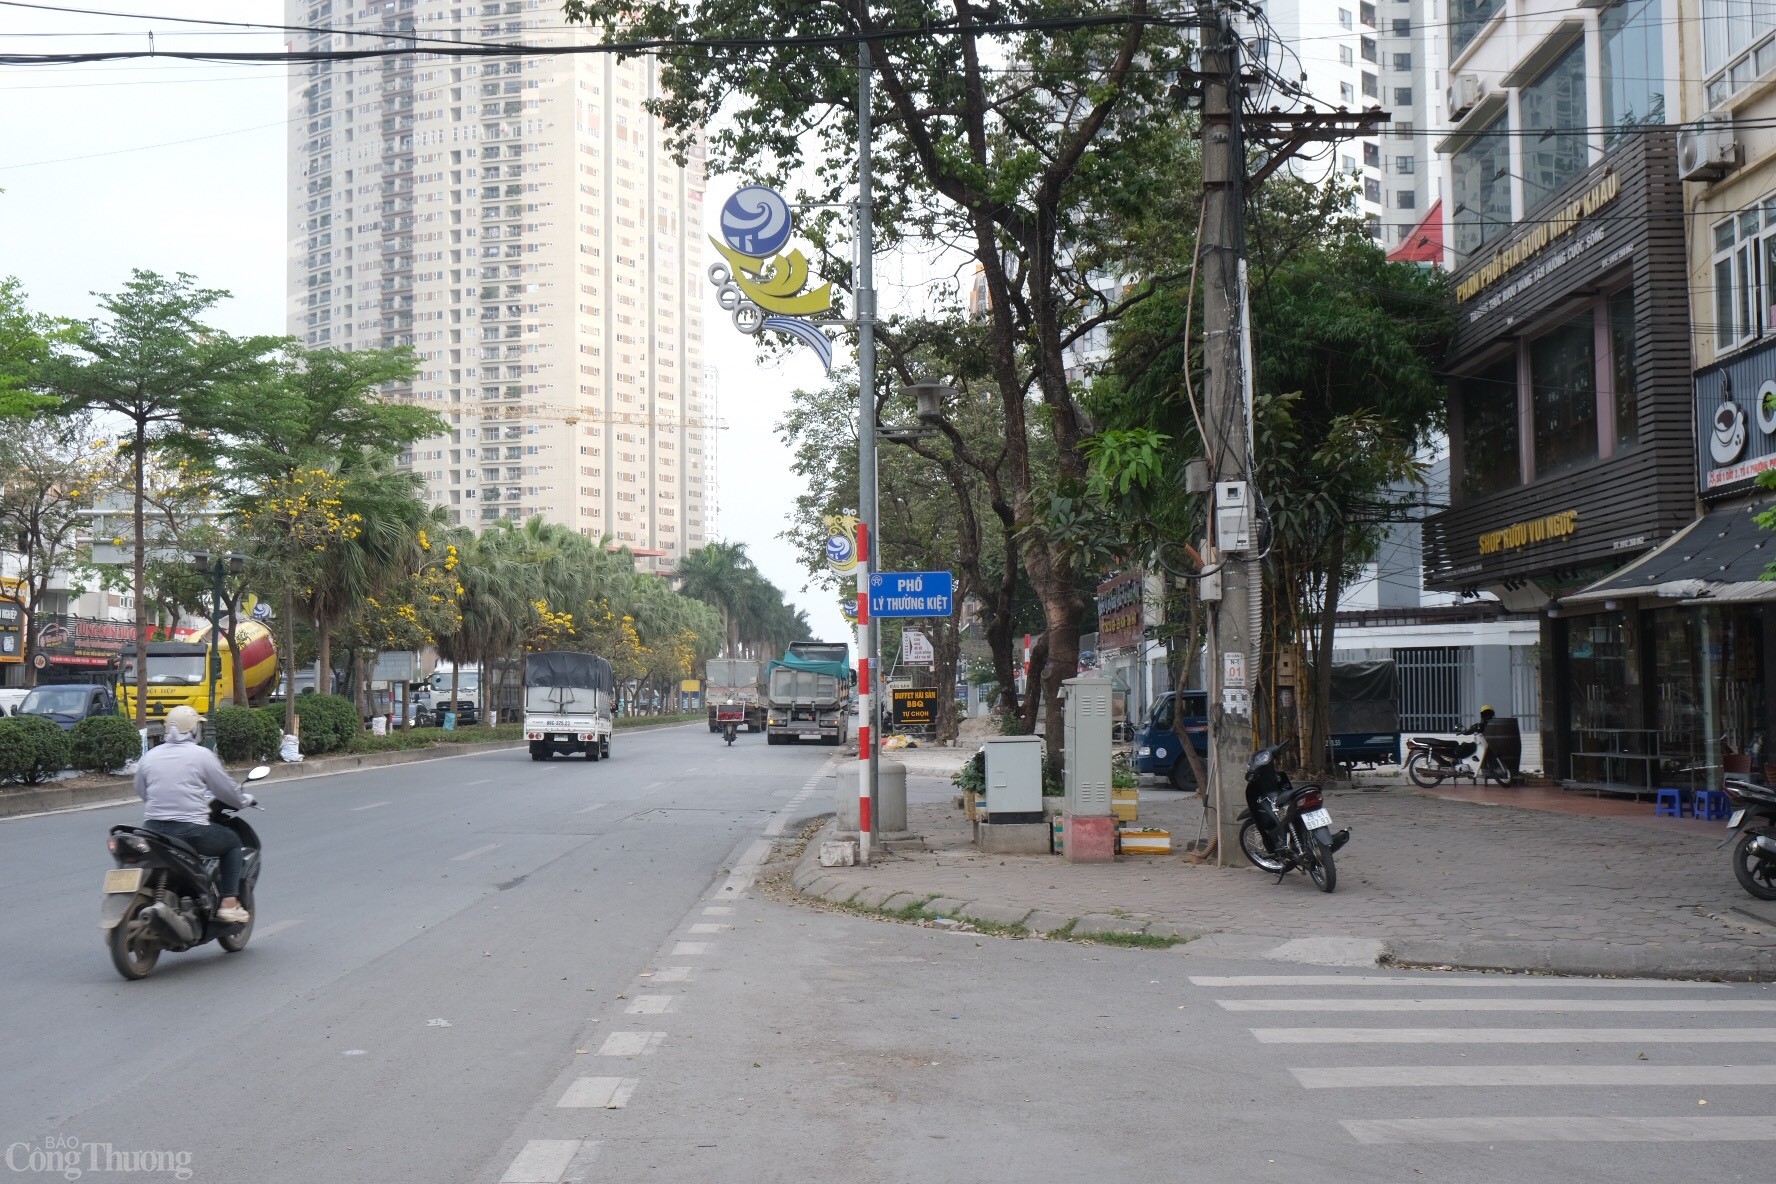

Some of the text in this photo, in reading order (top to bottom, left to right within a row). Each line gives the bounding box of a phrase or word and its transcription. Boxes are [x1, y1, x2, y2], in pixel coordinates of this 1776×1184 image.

[1503, 243, 1520, 273] BIA
[1549, 198, 1581, 240] NHẬP
[1583, 166, 1618, 218] KHẨU
[1567, 239, 1585, 260] CUỘC
[1586, 226, 1605, 249] SỐNG
[1479, 531, 1503, 555] SHOP
[1529, 517, 1545, 543] VUI
[898, 574, 923, 592] PHỐ
[873, 593, 948, 611] LÝ THƯỜNG KIỆT
[1230, 667, 1241, 677] 01
[894, 692, 914, 700] BUFFET
[907, 700, 924, 708] BBQ
